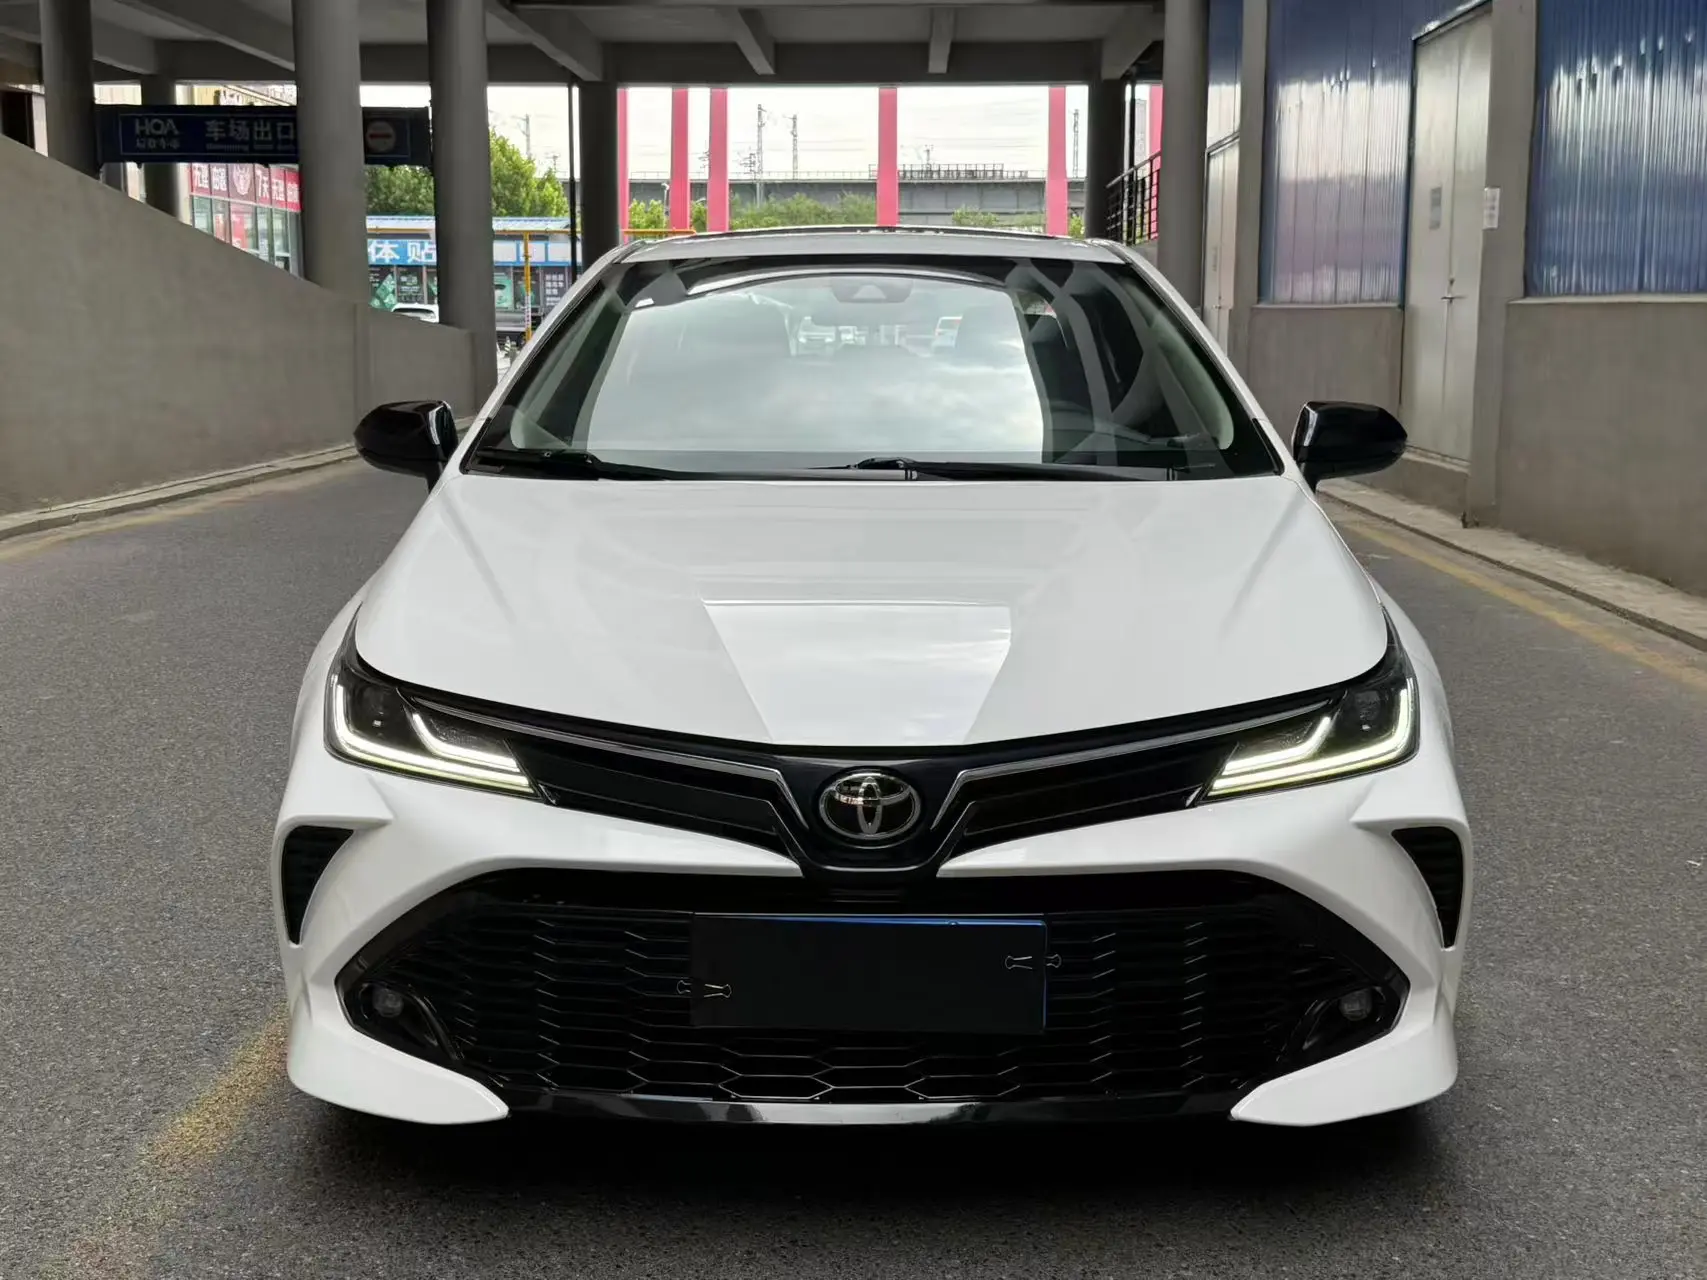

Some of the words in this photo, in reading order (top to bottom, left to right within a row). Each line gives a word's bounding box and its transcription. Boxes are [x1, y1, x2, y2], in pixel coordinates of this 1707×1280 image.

[204, 118, 294, 141] 车场出口
[367, 240, 437, 263] 体贴
